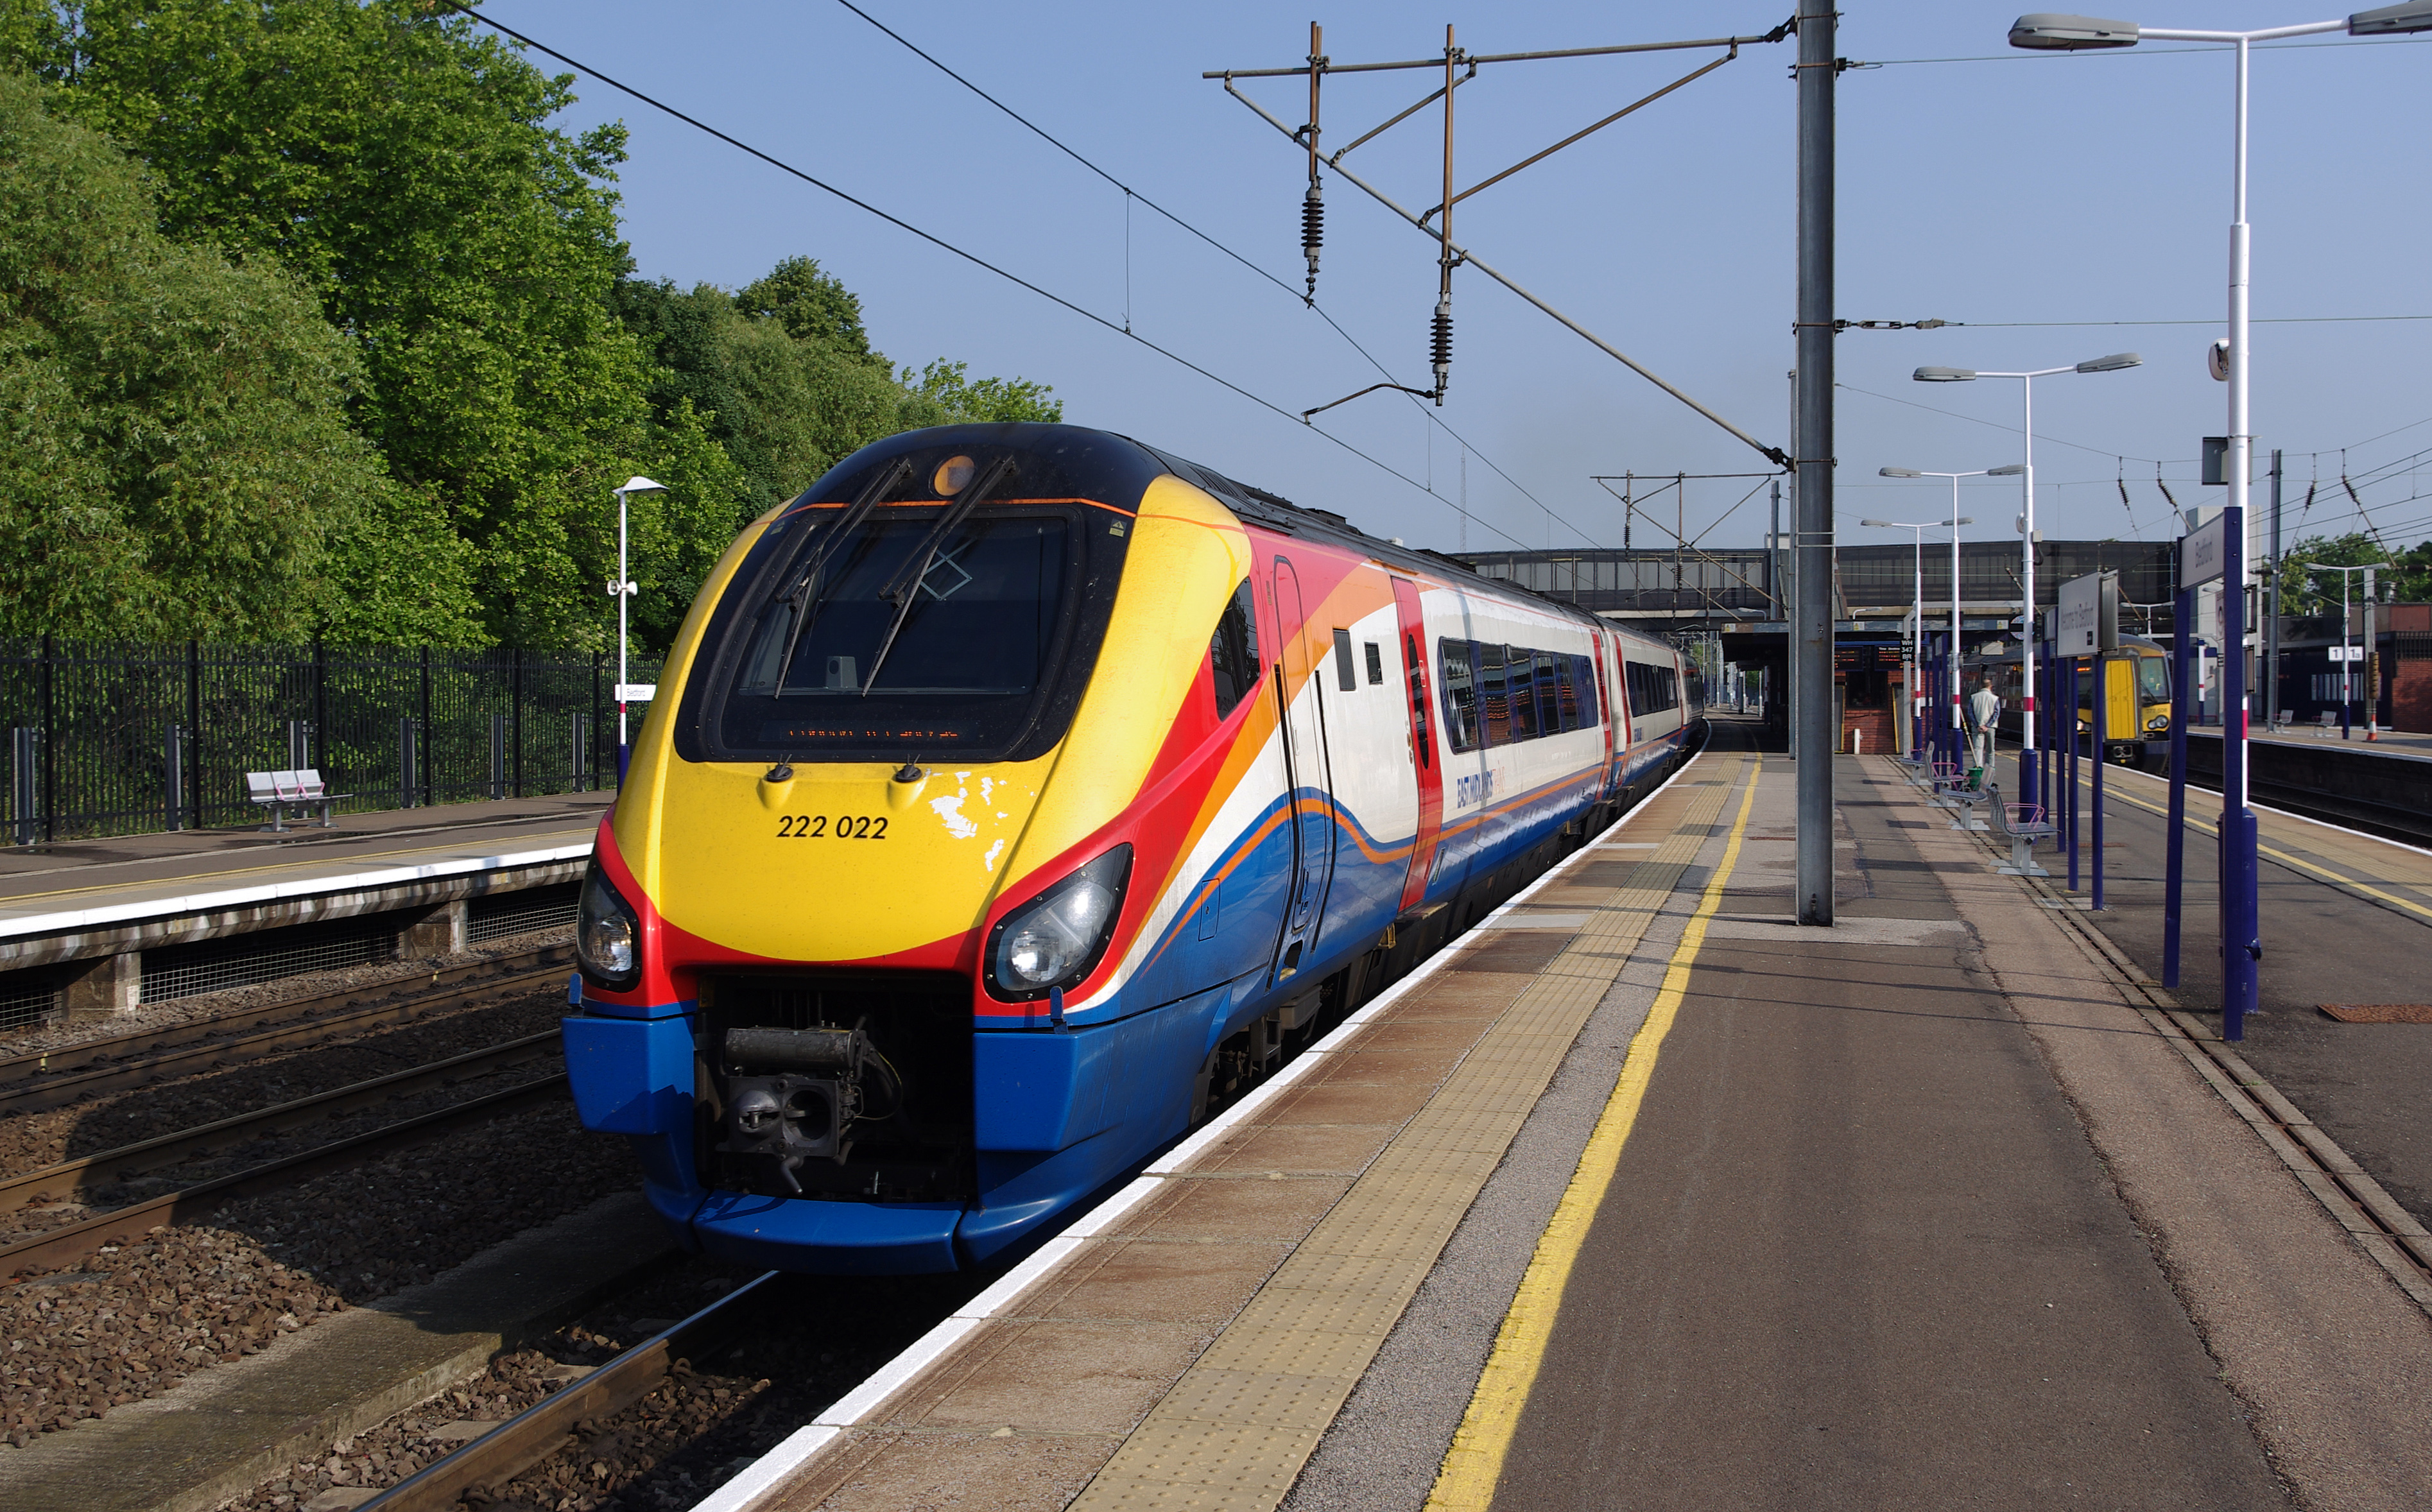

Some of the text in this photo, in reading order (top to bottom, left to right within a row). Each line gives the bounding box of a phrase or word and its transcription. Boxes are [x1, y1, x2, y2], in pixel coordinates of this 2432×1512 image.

[627, 688, 646, 697] Bedford
[776, 815, 888, 839] 222 022
